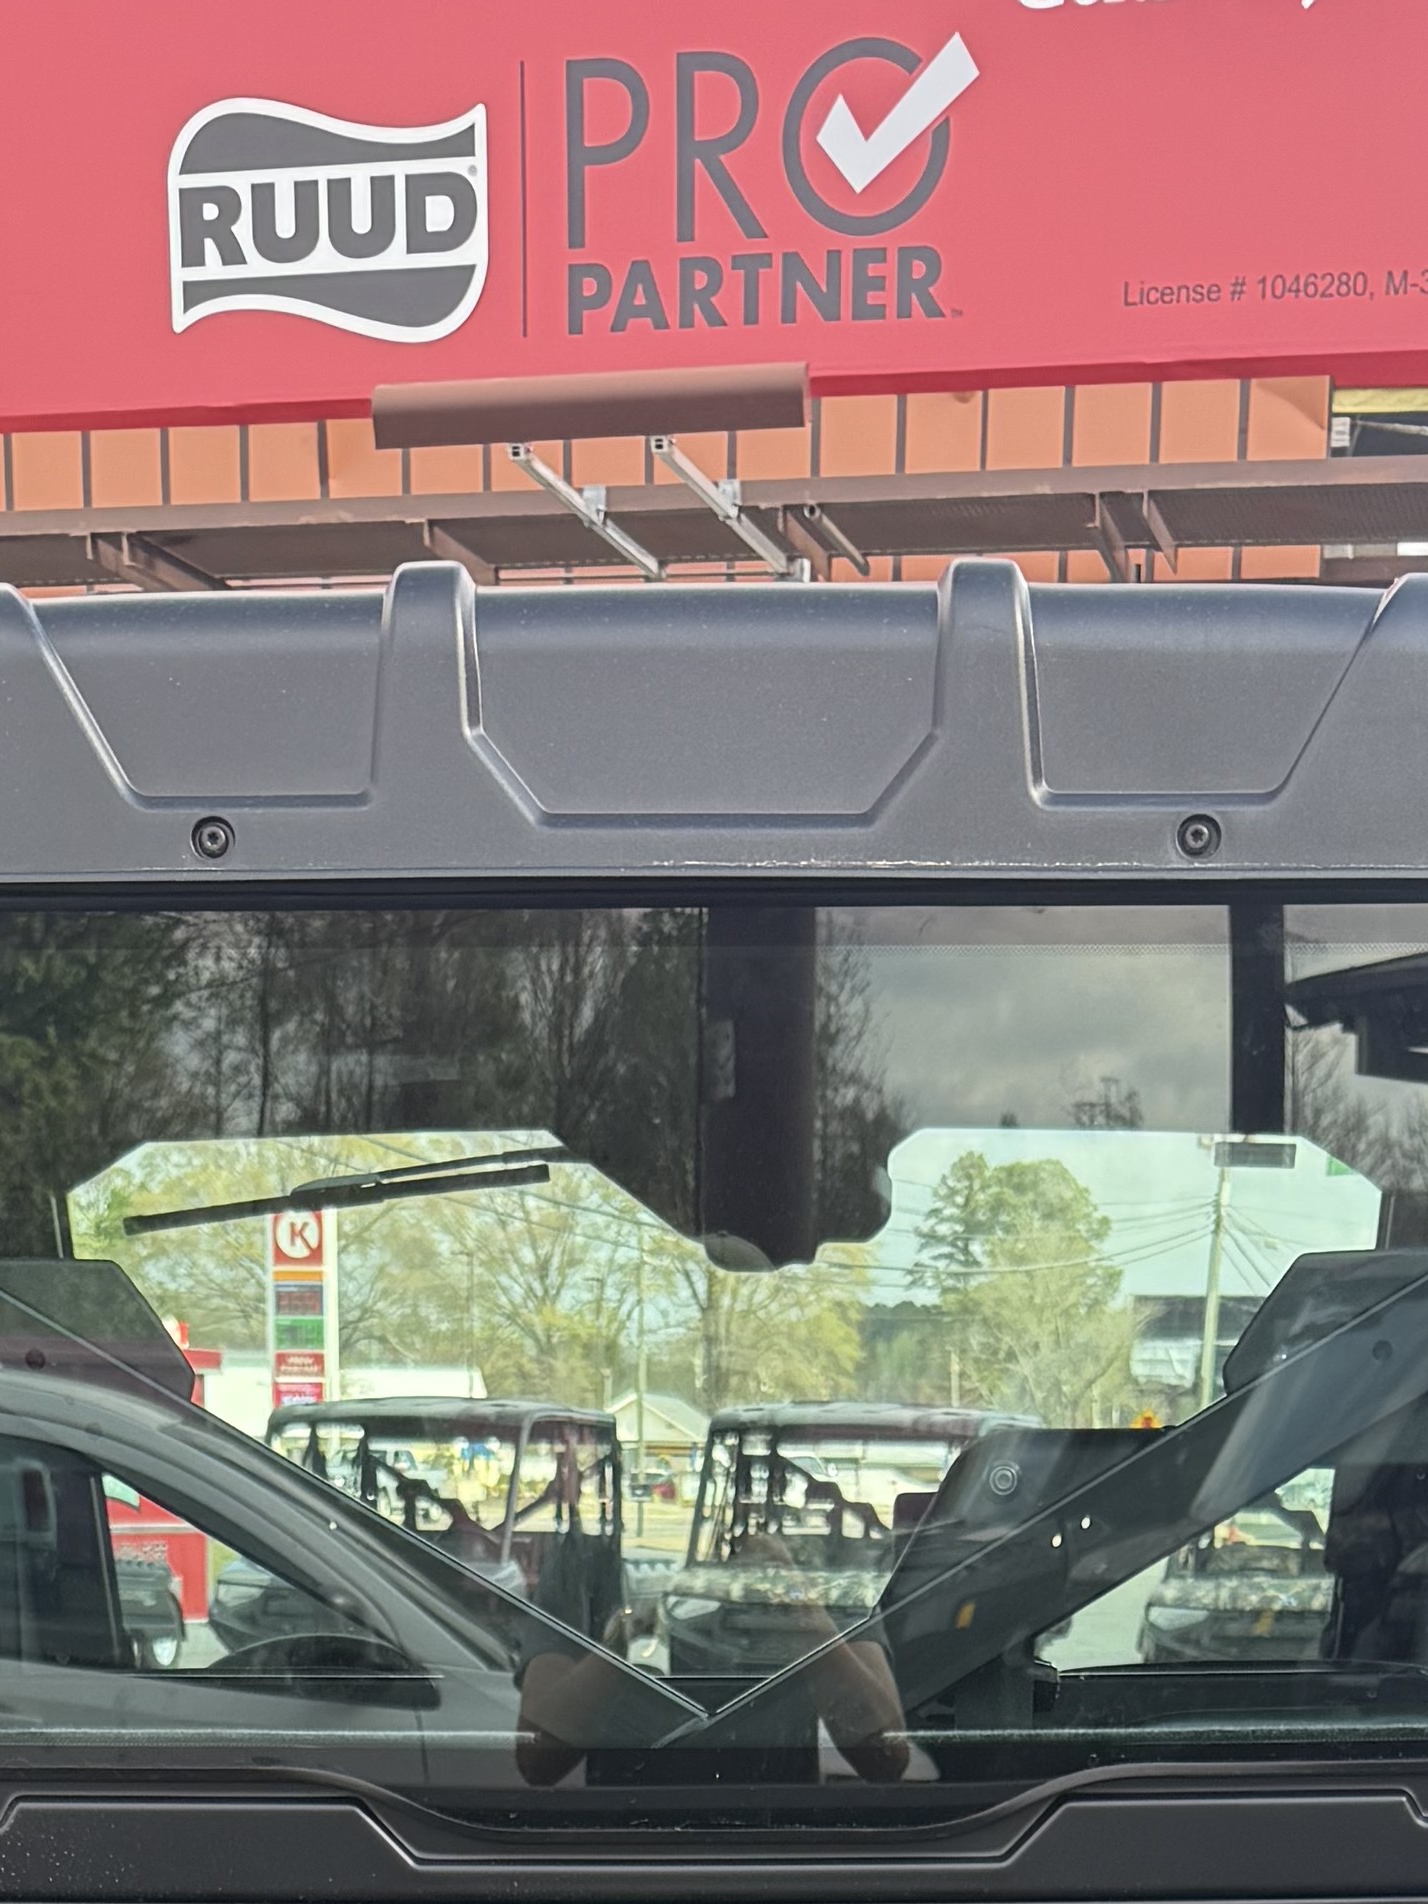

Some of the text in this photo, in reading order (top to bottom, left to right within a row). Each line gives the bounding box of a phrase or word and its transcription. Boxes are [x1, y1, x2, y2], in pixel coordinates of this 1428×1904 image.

[566, 36, 951, 249] PRO
[180, 171, 478, 269] RUUD
[568, 245, 945, 336] PARTNER
[1122, 280, 1222, 307] License
[1230, 276, 1247, 301] #
[1257, 271, 1375, 301] 1046280,
